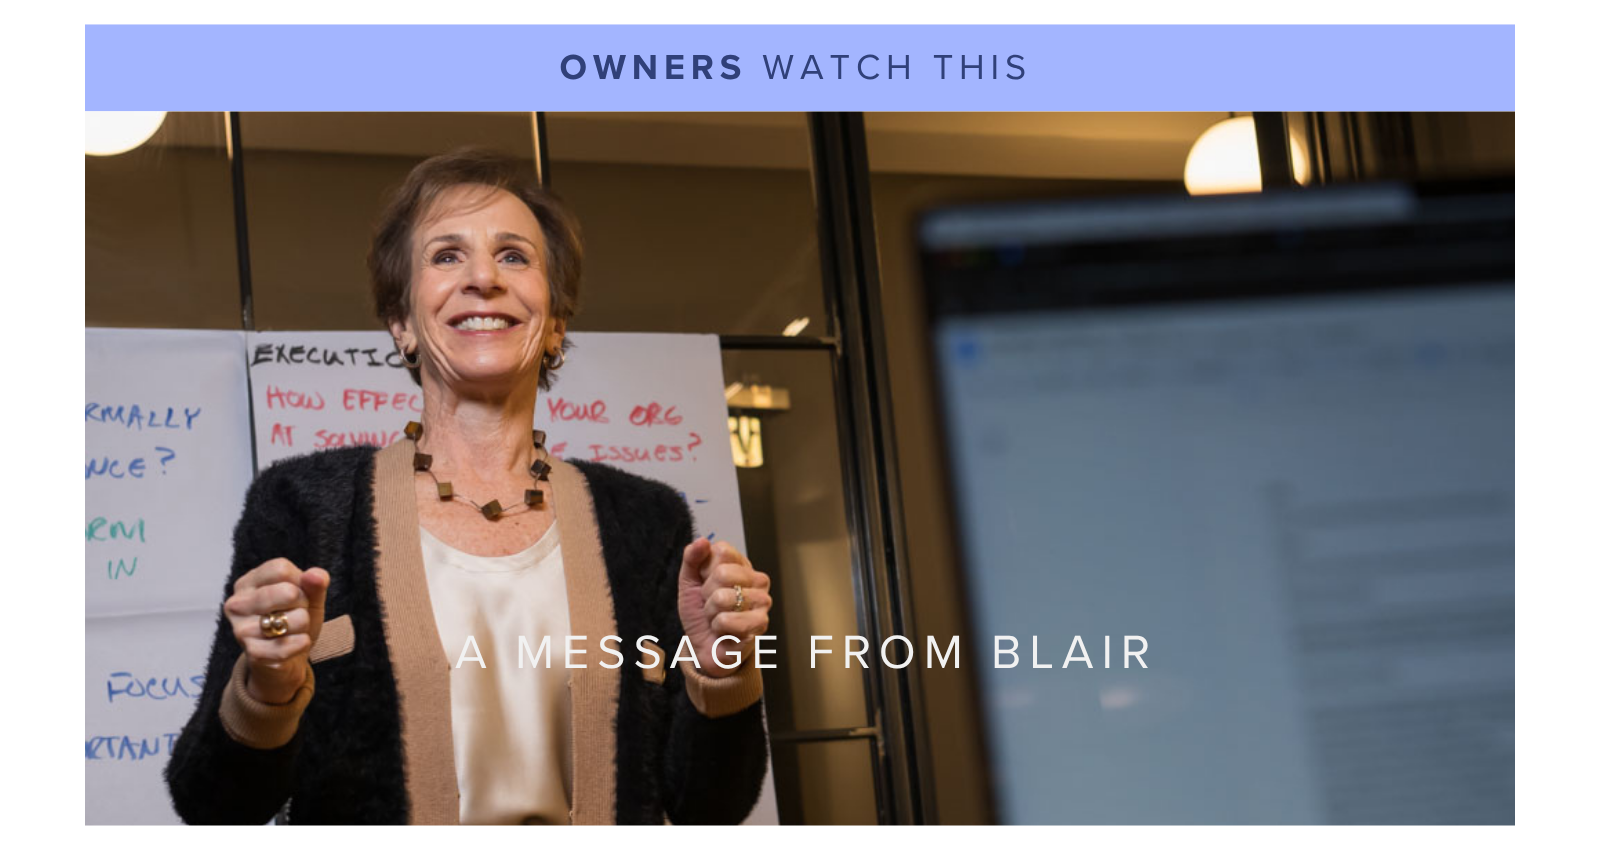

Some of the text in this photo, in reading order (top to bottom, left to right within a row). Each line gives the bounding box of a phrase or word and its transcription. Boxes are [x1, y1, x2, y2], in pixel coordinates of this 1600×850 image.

[266, 384, 423, 412] HOW EFFEC
[546, 397, 683, 427] YOUR ORG
[271, 422, 296, 447] AT
[588, 432, 702, 463] ISSUES?
[107, 672, 206, 703] FOCUS
